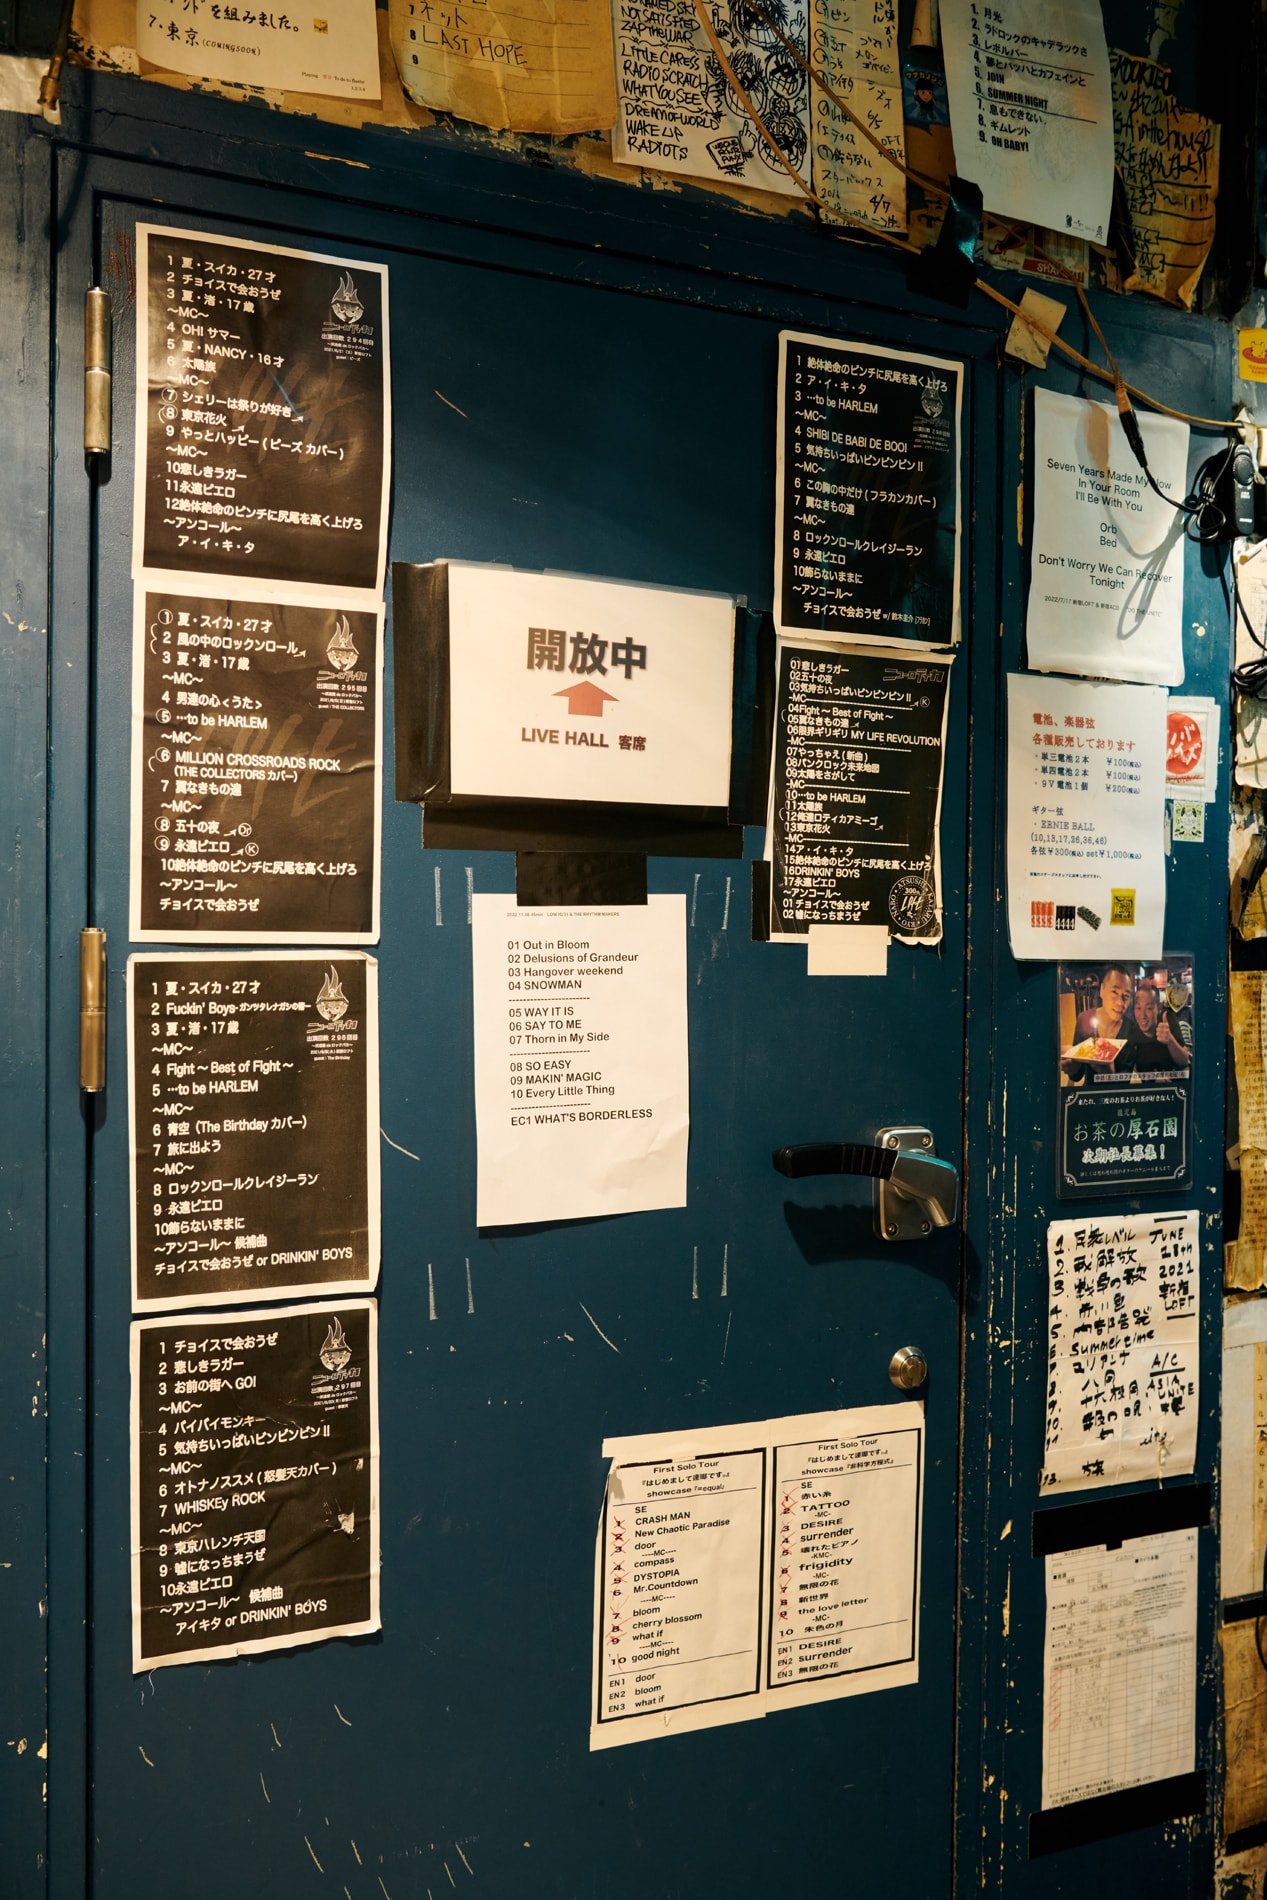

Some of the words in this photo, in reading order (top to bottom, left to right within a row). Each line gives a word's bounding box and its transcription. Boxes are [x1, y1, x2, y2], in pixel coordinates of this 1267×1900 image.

[211, 4, 299, 32] を組みました。
[984, 8, 1002, 23] 月光
[422, 25, 469, 54] LAST
[478, 37, 527, 65] HOPE
[987, 72, 1004, 84] JOIN
[987, 87, 1024, 104] SUMMER
[1025, 95, 1048, 110] NIGHT
[626, 119, 660, 137] WAKE
[991, 120, 1031, 136] ギムレット
[991, 136, 1002, 147] OH
[1004, 138, 1029, 152] BABY!
[182, 274, 281, 300] チョイスで会おうぜ
[182, 323, 203, 337] OH!
[208, 327, 241, 342] サマー
[182, 357, 216, 373] 太陽族
[182, 392, 292, 418] シェリーは祭りが好き
[827, 396, 836, 407] be
[838, 398, 878, 414] HARLEM
[181, 409, 227, 426] 東京花火
[806, 426, 829, 441] SHIBI
[832, 431, 843, 443] DE
[845, 433, 866, 447] BABI
[870, 437, 881, 449] DE
[1047, 458, 1076, 473] Seven
[1078, 465, 1105, 478] Years
[1107, 470, 1132, 484] Made
[1135, 475, 1148, 487] My
[1078, 478, 1086, 488] In
[1089, 480, 1111, 493] Your
[1114, 485, 1140, 498] Room
[1088, 492, 1099, 504] Be
[1102, 495, 1122, 507] With
[1126, 500, 1143, 512] You
[1100, 522, 1117, 534] Orb
[1100, 536, 1116, 548] Bed
[1039, 554, 1065, 566] Don't
[1067, 559, 1096, 573] Worry
[1099, 564, 1113, 574] We
[1116, 566, 1133, 577] Can
[1136, 569, 1173, 583] Recover
[1090, 575, 1125, 589] Tonight
[177, 633, 298, 654] 風の中のロックンロール
[526, 627, 647, 680] 開放中
[1033, 713, 1095, 730] 電池、楽器弦
[521, 728, 559, 744] LIVE
[565, 732, 609, 748] HALL
[618, 734, 646, 751] 客席
[851, 730, 865, 740] MY
[867, 731, 884, 741] LIFE
[887, 734, 940, 747] REVOLUTION
[1032, 733, 1136, 752] 各種販売しております
[176, 752, 225, 765] MILLION
[227, 754, 306, 768] CROSSROADS
[309, 758, 340, 771] ROCK
[200, 768, 265, 780] COLLECTORS
[1032, 806, 1064, 816] ギター弦
[175, 820, 220, 834] 五十の夜
[1041, 821, 1069, 830] ERNIE
[1072, 822, 1095, 831] BALL
[175, 839, 229, 853] 永遠ピエロ
[523, 940, 542, 950] Out
[545, 941, 554, 949] in
[557, 940, 589, 949] Bloom
[524, 954, 575, 963] Delusions
[577, 953, 587, 962] of
[590, 953, 638, 962] Grandeur
[524, 968, 575, 979] Hangover
[577, 967, 623, 975] weekend
[524, 980, 582, 990] SNOWMAN
[166, 1003, 205, 1016] Fuckin'
[525, 1008, 548, 1017] WAY
[551, 1007, 561, 1016] IT
[564, 1007, 574, 1015] IS
[525, 1021, 546, 1030] SAY
[549, 1020, 563, 1030] TO
[566, 1020, 582, 1029] ME
[525, 1034, 555, 1044] Thorn
[558, 1034, 567, 1043] in
[570, 1033, 584, 1044] My
[587, 1032, 610, 1041] Side
[167, 1063, 195, 1076] Fight
[211, 1062, 236, 1074] Best
[239, 1061, 250, 1073] of
[526, 1062, 541, 1071] SO
[544, 1060, 571, 1070] EASY
[526, 1074, 564, 1084] MAKIN'
[566, 1072, 602, 1082] MAGIC
[526, 1088, 555, 1099] Every
[558, 1087, 583, 1096] Little
[586, 1085, 615, 1095] Thing
[511, 1116, 531, 1126] EC1
[535, 1113, 576, 1124] WHAT'S
[579, 1109, 653, 1121] BORDERLESS
[168, 1123, 190, 1136] 青空
[223, 1119, 268, 1133] Birthday
[1074, 1116, 1178, 1142] お茶の厚石園
[168, 1140, 221, 1156] 旅に出よう
[169, 1174, 319, 1195] ロックンロールクレイジーラン
[1159, 1263, 1194, 1278] 2021
[1164, 1296, 1195, 1311] LOFT
[174, 1333, 278, 1354] チョイスで会おうぜ
[174, 1357, 244, 1374] 悲しきラガー
[678, 1463, 696, 1472] Solo
[647, 1487, 692, 1498] showcase
[801, 1500, 850, 1512] TATTOO
[636, 1515, 667, 1526] CRASH
[670, 1512, 691, 1520] MAN
[801, 1518, 843, 1530] DESIRE
[635, 1529, 654, 1538] New
[657, 1523, 690, 1535] Chaotic
[692, 1519, 730, 1529] Paradise
[801, 1527, 854, 1542] surrender
[174, 1529, 266, 1555] 東京ハレンチ天国
[634, 1557, 675, 1568] compass
[799, 1557, 853, 1571] frigidity
[634, 1568, 680, 1582] DYSTOPIA
[634, 1578, 698, 1593] Mr.Countdown
[249, 1585, 283, 1604] 候補曲
[818, 1604, 839, 1612] love
[842, 1598, 869, 1607] letter
[176, 1617, 221, 1636] アイキタ
[225, 1614, 238, 1626] or
[240, 1607, 292, 1624] DRINKIN'
[295, 1599, 327, 1616] BOYS
[632, 1618, 663, 1630] cherry
[665, 1613, 702, 1625] blossom
[632, 1652, 654, 1663] good
[656, 1647, 680, 1658] night
